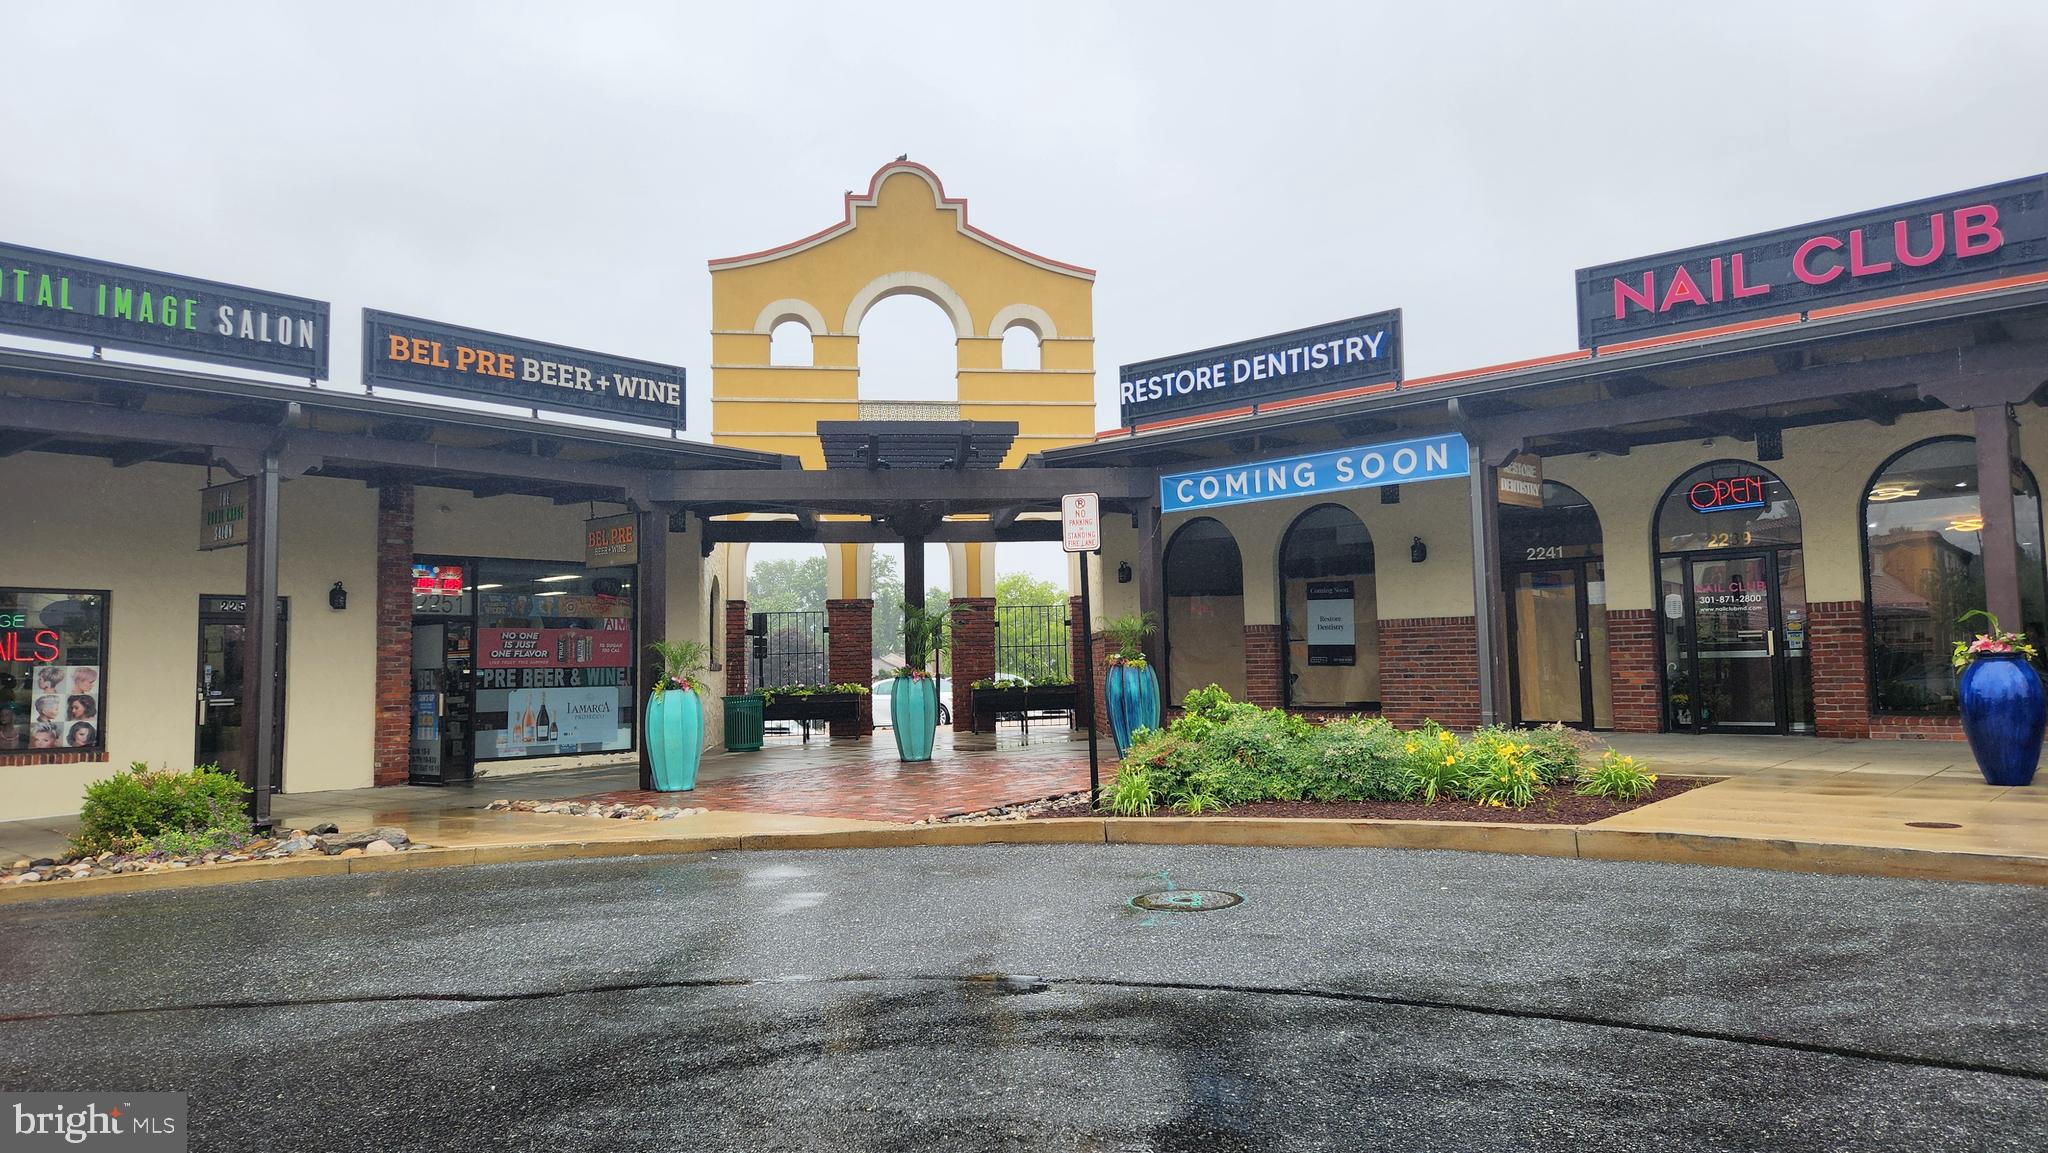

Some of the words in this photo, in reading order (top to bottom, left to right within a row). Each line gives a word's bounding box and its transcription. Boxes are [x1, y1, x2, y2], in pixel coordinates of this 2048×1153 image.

[1614, 253, 1770, 319] NAIL
[1793, 204, 2003, 286] CLUB
[0, 268, 74, 311] TAL
[97, 284, 197, 330] IMAGE
[218, 305, 313, 349] SALON
[389, 334, 449, 369] BEL
[456, 346, 515, 379] PRE
[1121, 365, 1226, 405] RESTORE
[1234, 331, 1385, 385] DENTISTRY
[1177, 463, 1316, 503] COMING
[1336, 443, 1448, 482] SOON
[1500, 477, 1540, 497] DENTISTRY
[1690, 475, 1763, 508] OPEN
[1069, 519, 1093, 527] PARKING
[1075, 510, 1086, 518] NO
[589, 529, 609, 548] BEL
[611, 526, 633, 544] PRE
[1708, 531, 1751, 548] 2239
[1526, 546, 1563, 561] 2241
[1695, 584, 1725, 593] NAIL
[1729, 580, 1767, 592] CLUB
[415, 595, 463, 614] 2251
[1700, 594, 1762, 604] 301-871-2800
[502, 632, 517, 640] NO
[519, 632, 539, 640] ONE
[491, 650, 511, 658] ONE
[513, 650, 548, 658] FLAVOR
[483, 668, 517, 688] PRE
[522, 668, 565, 687] BEER
[570, 668, 581, 686] &
[586, 667, 625, 686] WINE
